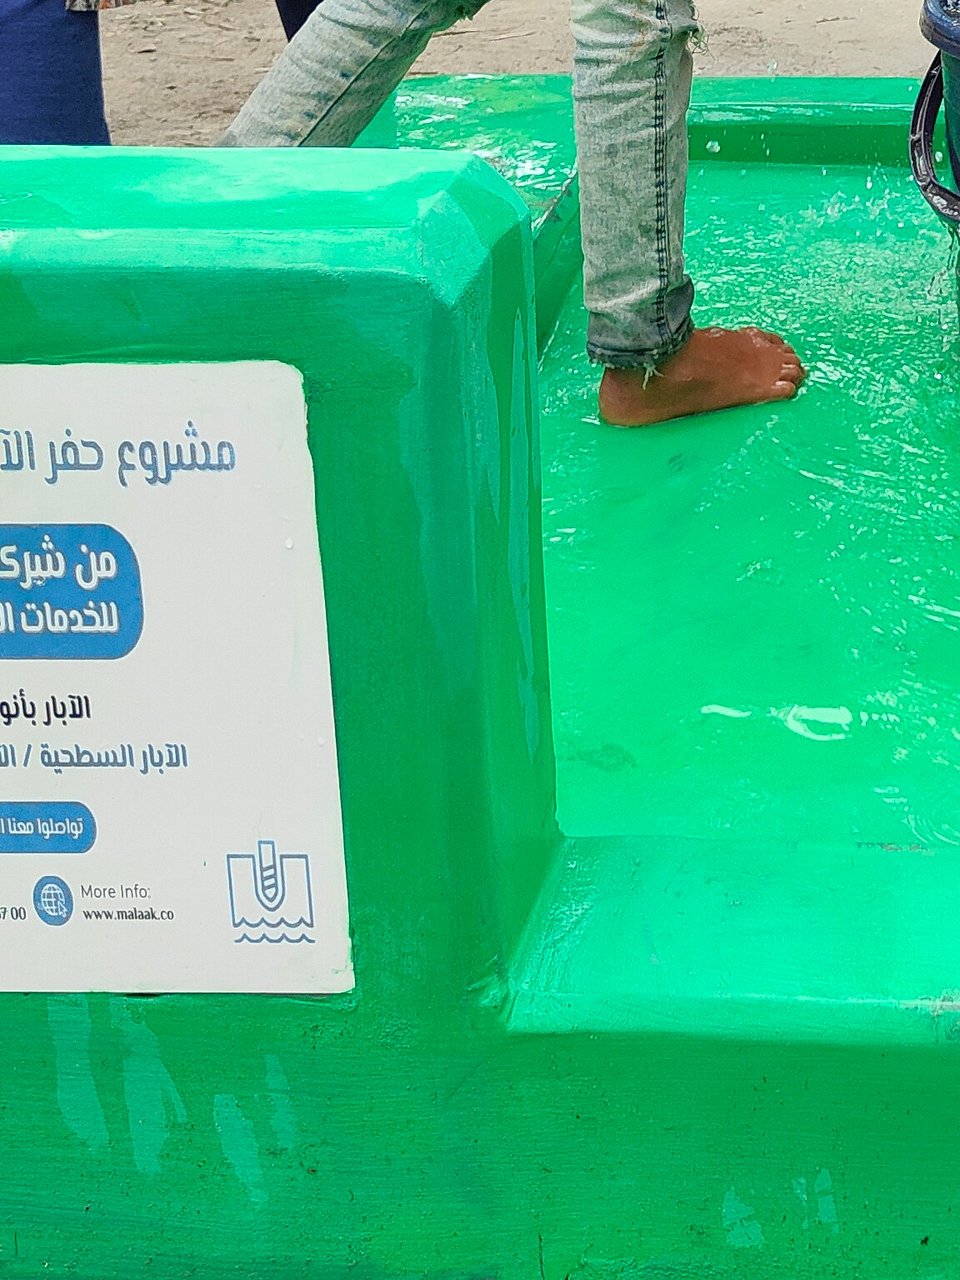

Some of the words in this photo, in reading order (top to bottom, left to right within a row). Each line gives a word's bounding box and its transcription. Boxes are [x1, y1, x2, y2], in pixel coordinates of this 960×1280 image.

[44, 428, 104, 485] حفر
[117, 420, 236, 487] مشروع
[75, 544, 117, 590] من
[20, 601, 119, 632] للخدمات
[43, 694, 91, 726] الآبار
[40, 743, 135, 774] السطحية
[139, 743, 188, 775] الآبار
[8, 817, 34, 834] معنا
[38, 817, 83, 840] تواصلوا
[81, 884, 116, 899] More
[121, 883, 151, 899] Info:
[10, 906, 27, 920] 00
[82, 907, 174, 921] www.malaak.co
